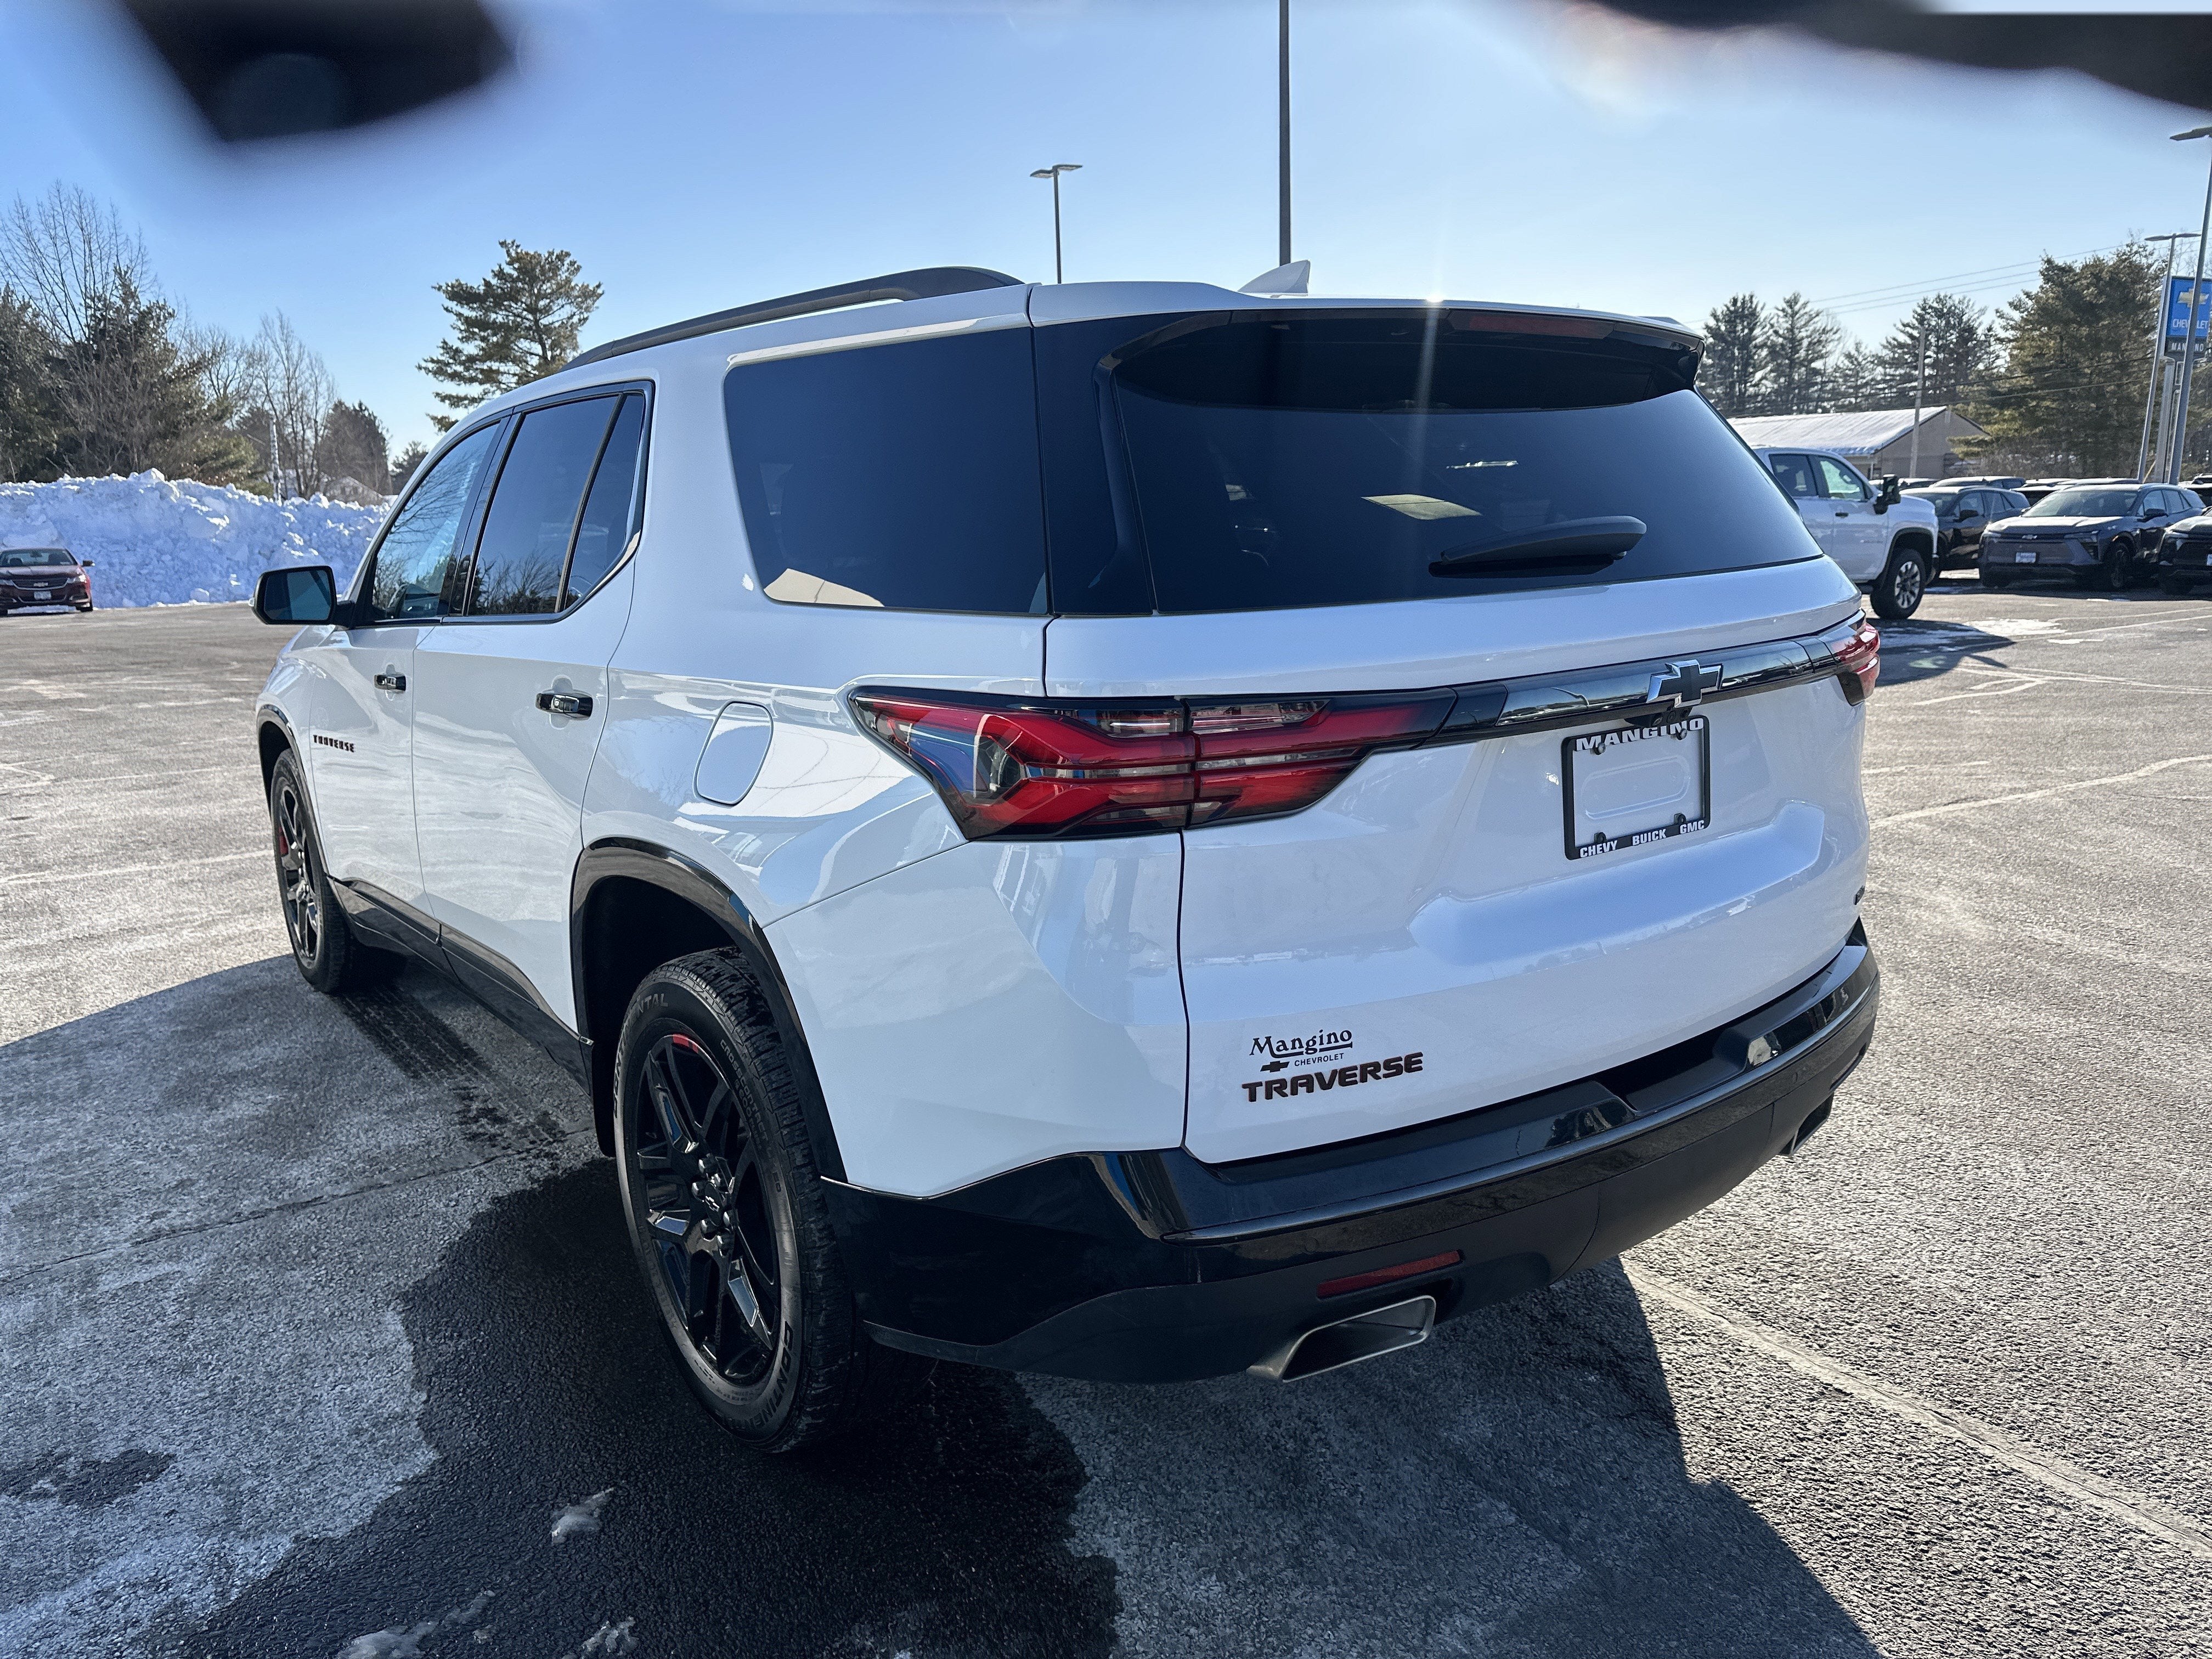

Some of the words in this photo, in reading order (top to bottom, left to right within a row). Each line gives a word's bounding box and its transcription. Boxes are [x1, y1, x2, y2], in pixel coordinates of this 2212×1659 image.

[2173, 319, 2208, 329] CHEVLET
[2172, 342, 2204, 351] MANNO
[313, 735, 354, 753] TRAVERSE
[1576, 718, 1703, 751] MANGINO
[1579, 840, 1617, 857] CHEVY
[1632, 829, 1667, 846] BUICK
[1680, 820, 1705, 834] GMC
[1249, 1029, 1353, 1058] Mangino
[1294, 1052, 1344, 1067] CHEVROLET
[1242, 1052, 1424, 1103] TRAVERSE
